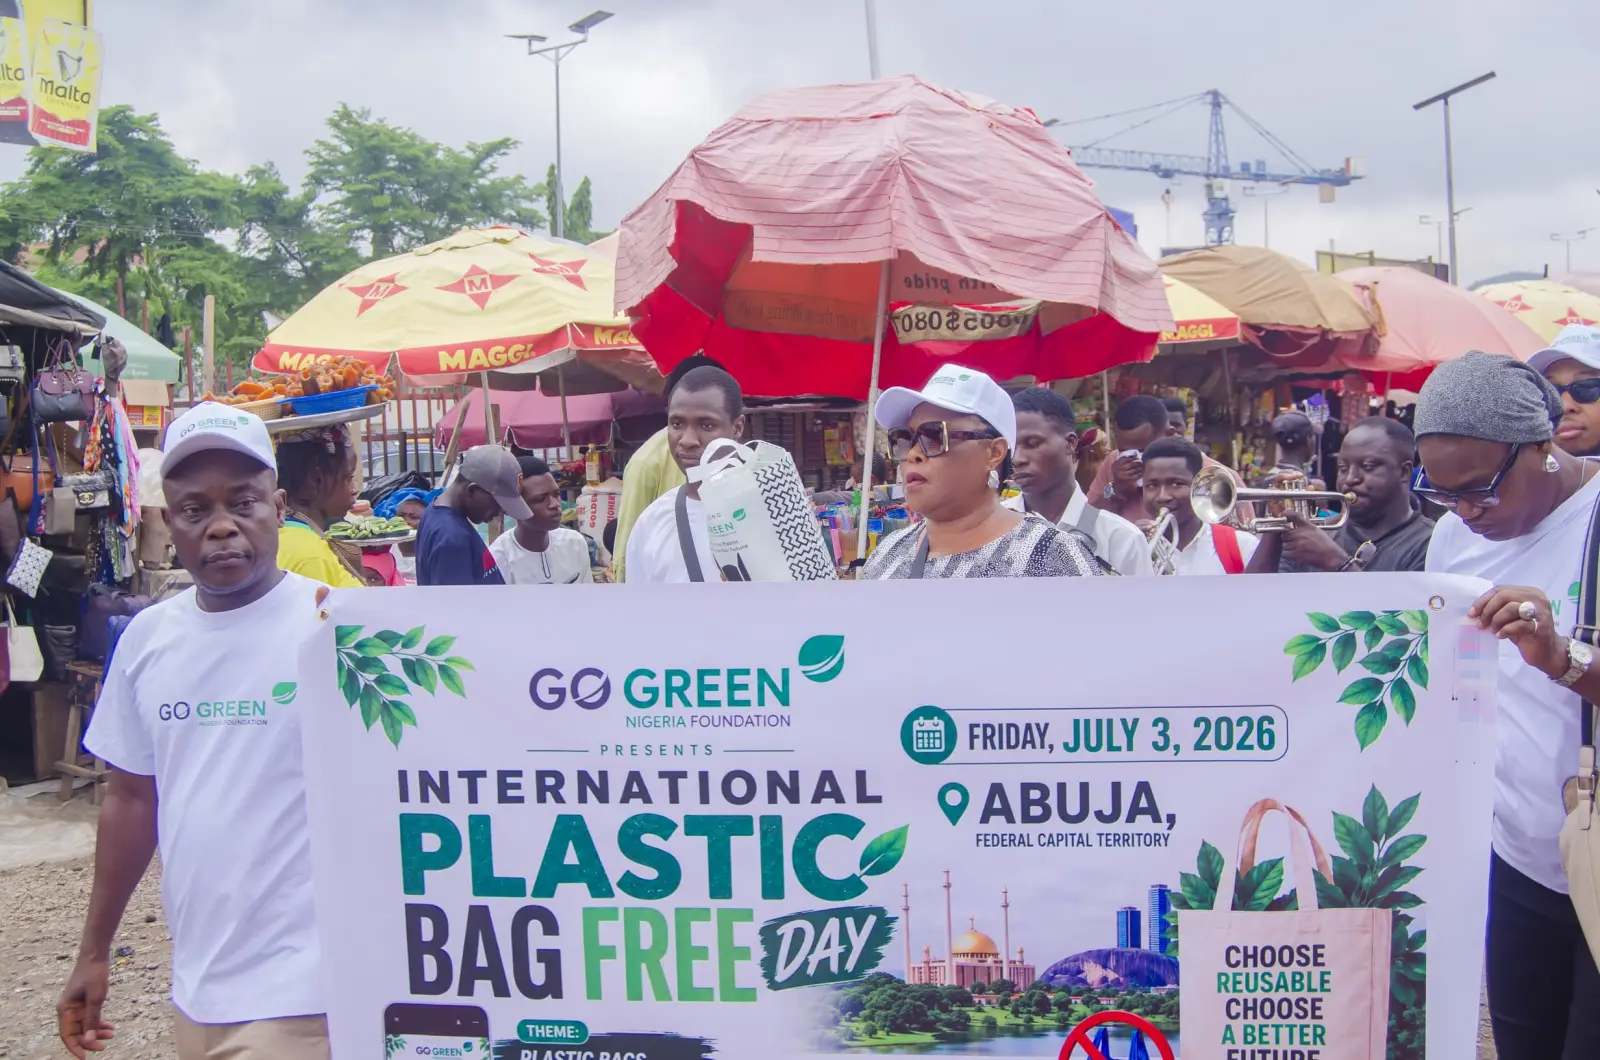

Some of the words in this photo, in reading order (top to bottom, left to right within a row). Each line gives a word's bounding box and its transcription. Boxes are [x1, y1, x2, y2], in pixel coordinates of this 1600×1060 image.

[0, 63, 25, 81] lta
[468, 278, 488, 292] M
[593, 326, 640, 345] MAG
[279, 351, 332, 371] MAG
[180, 423, 196, 437] GO
[198, 417, 238, 427] GREEN
[529, 667, 611, 710] GO
[624, 668, 790, 709] GREEN
[159, 702, 190, 721] GO
[196, 701, 266, 717] GREEN
[626, 715, 686, 728] NIGERIA
[691, 714, 791, 728] FOUNDATION
[969, 723, 1054, 754] FRIDAY,
[1063, 718, 1139, 753] JULY
[1152, 717, 1181, 756] 3,
[1194, 715, 1275, 751] 2026
[600, 744, 713, 756] PRESENTS
[398, 769, 883, 805] INTERNATIONAL
[979, 781, 1177, 830] ABUJA,
[976, 833, 1034, 848] FEDERAL
[1038, 833, 1092, 848] CAPITAL
[1096, 833, 1170, 848] TERRITORY
[399, 813, 869, 901] PLASTIC
[404, 903, 563, 1000] BAG
[582, 907, 757, 1003] FREE
[775, 914, 877, 983] DAY
[1225, 944, 1326, 968] CHOOSE
[1217, 971, 1331, 993] REUSABLE
[1225, 997, 1324, 1020] CHOOSE
[526, 1024, 580, 1039] THEME:
[1221, 1024, 1236, 1045] A
[1243, 1024, 1326, 1046] BETTER
[416, 1046, 431, 1055] GO
[432, 1047, 462, 1056] GREEN
